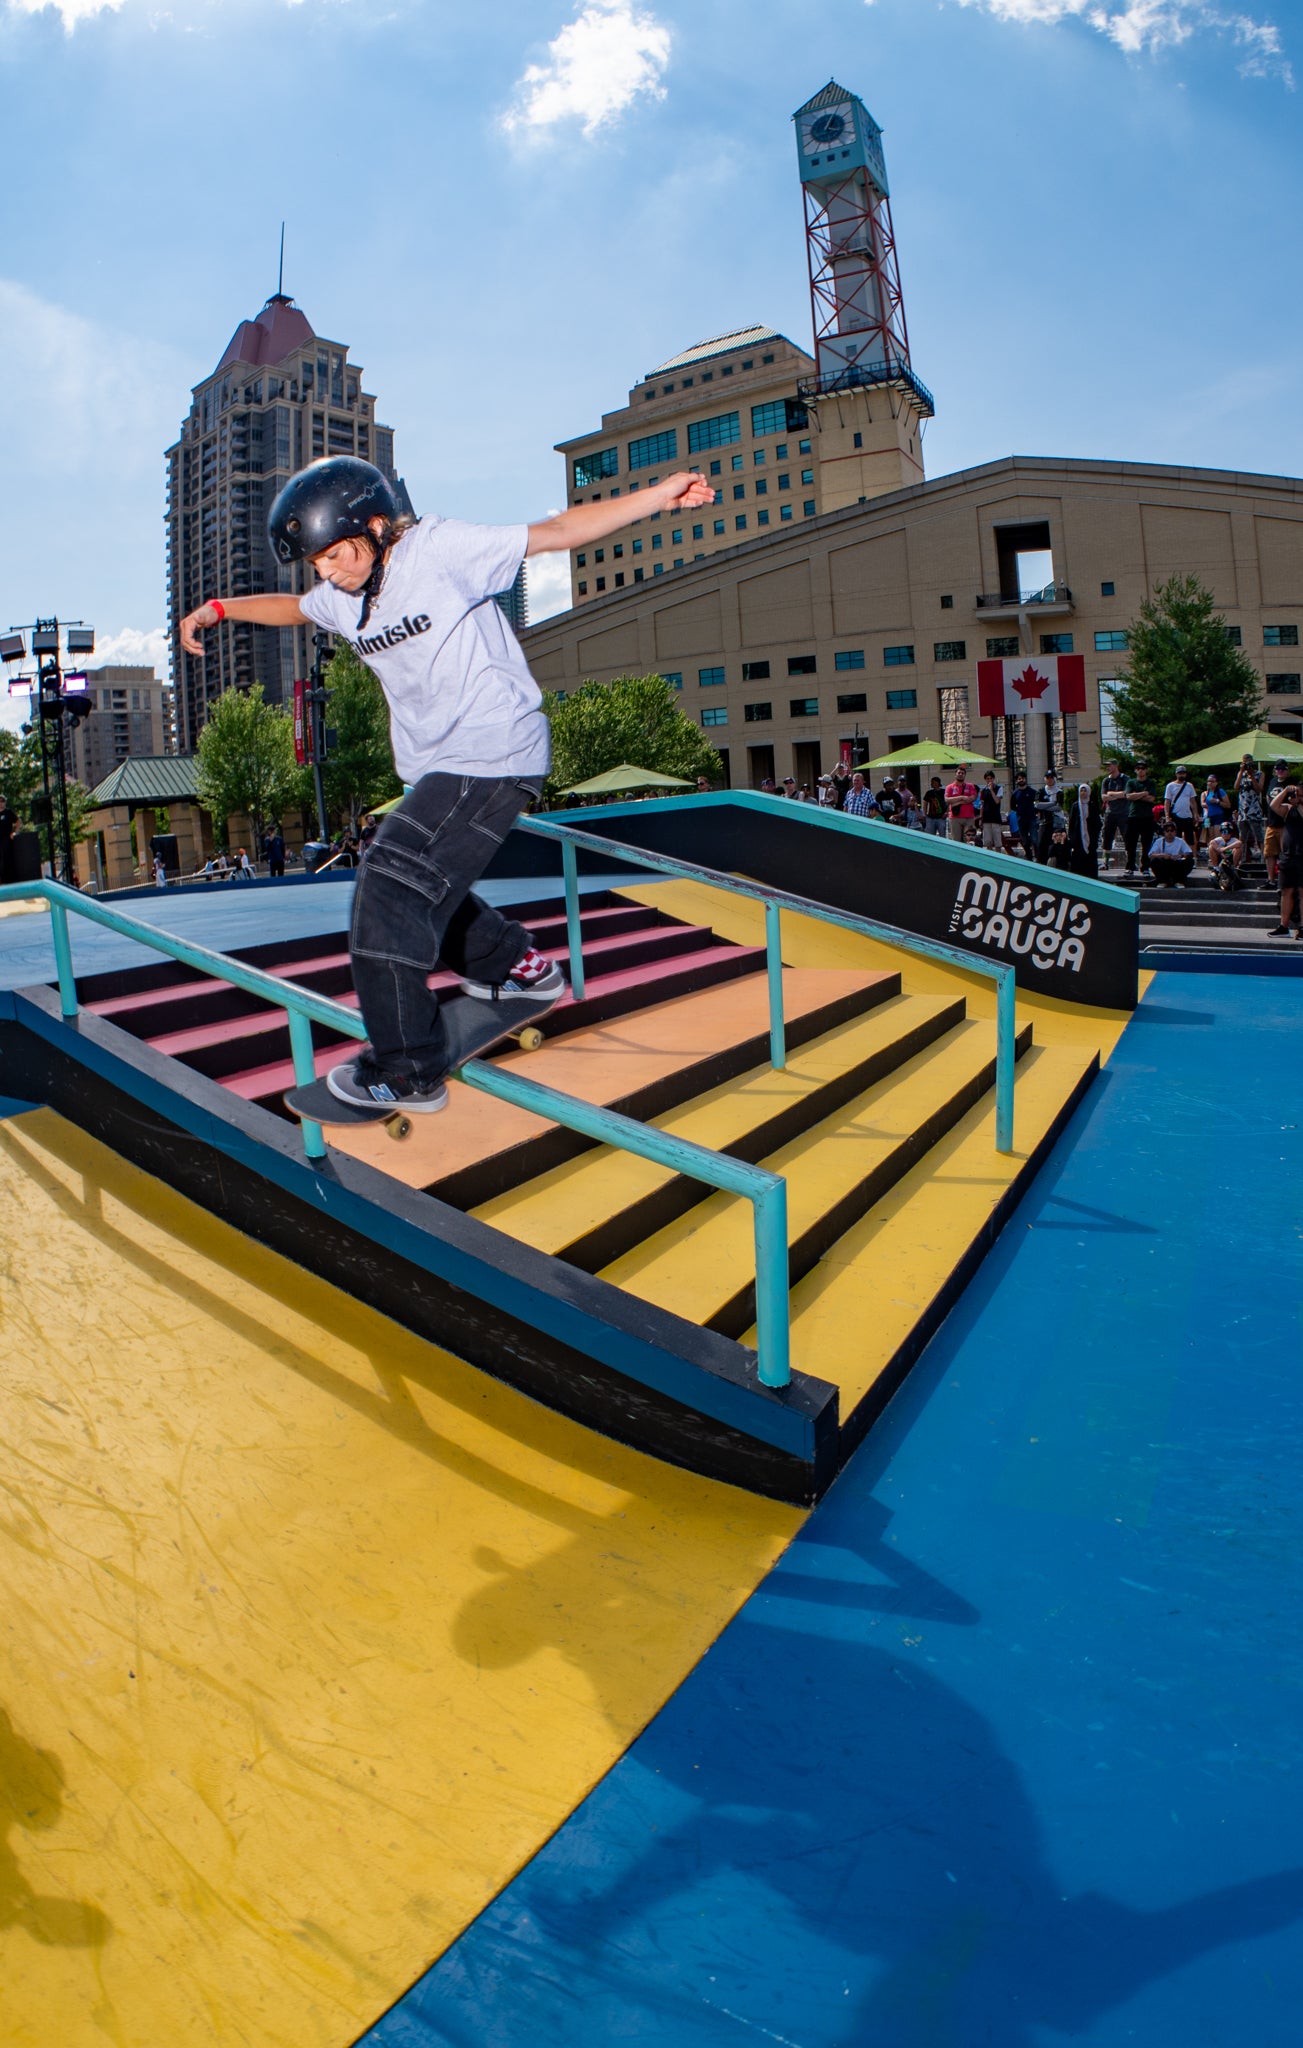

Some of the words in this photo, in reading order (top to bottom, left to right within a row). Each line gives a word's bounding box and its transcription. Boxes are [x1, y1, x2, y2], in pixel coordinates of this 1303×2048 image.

[948, 900, 963, 933] VISIT
[957, 871, 1092, 936] MISSIS
[962, 907, 1086, 973] SAUGA
[368, 1083, 397, 1105] N
